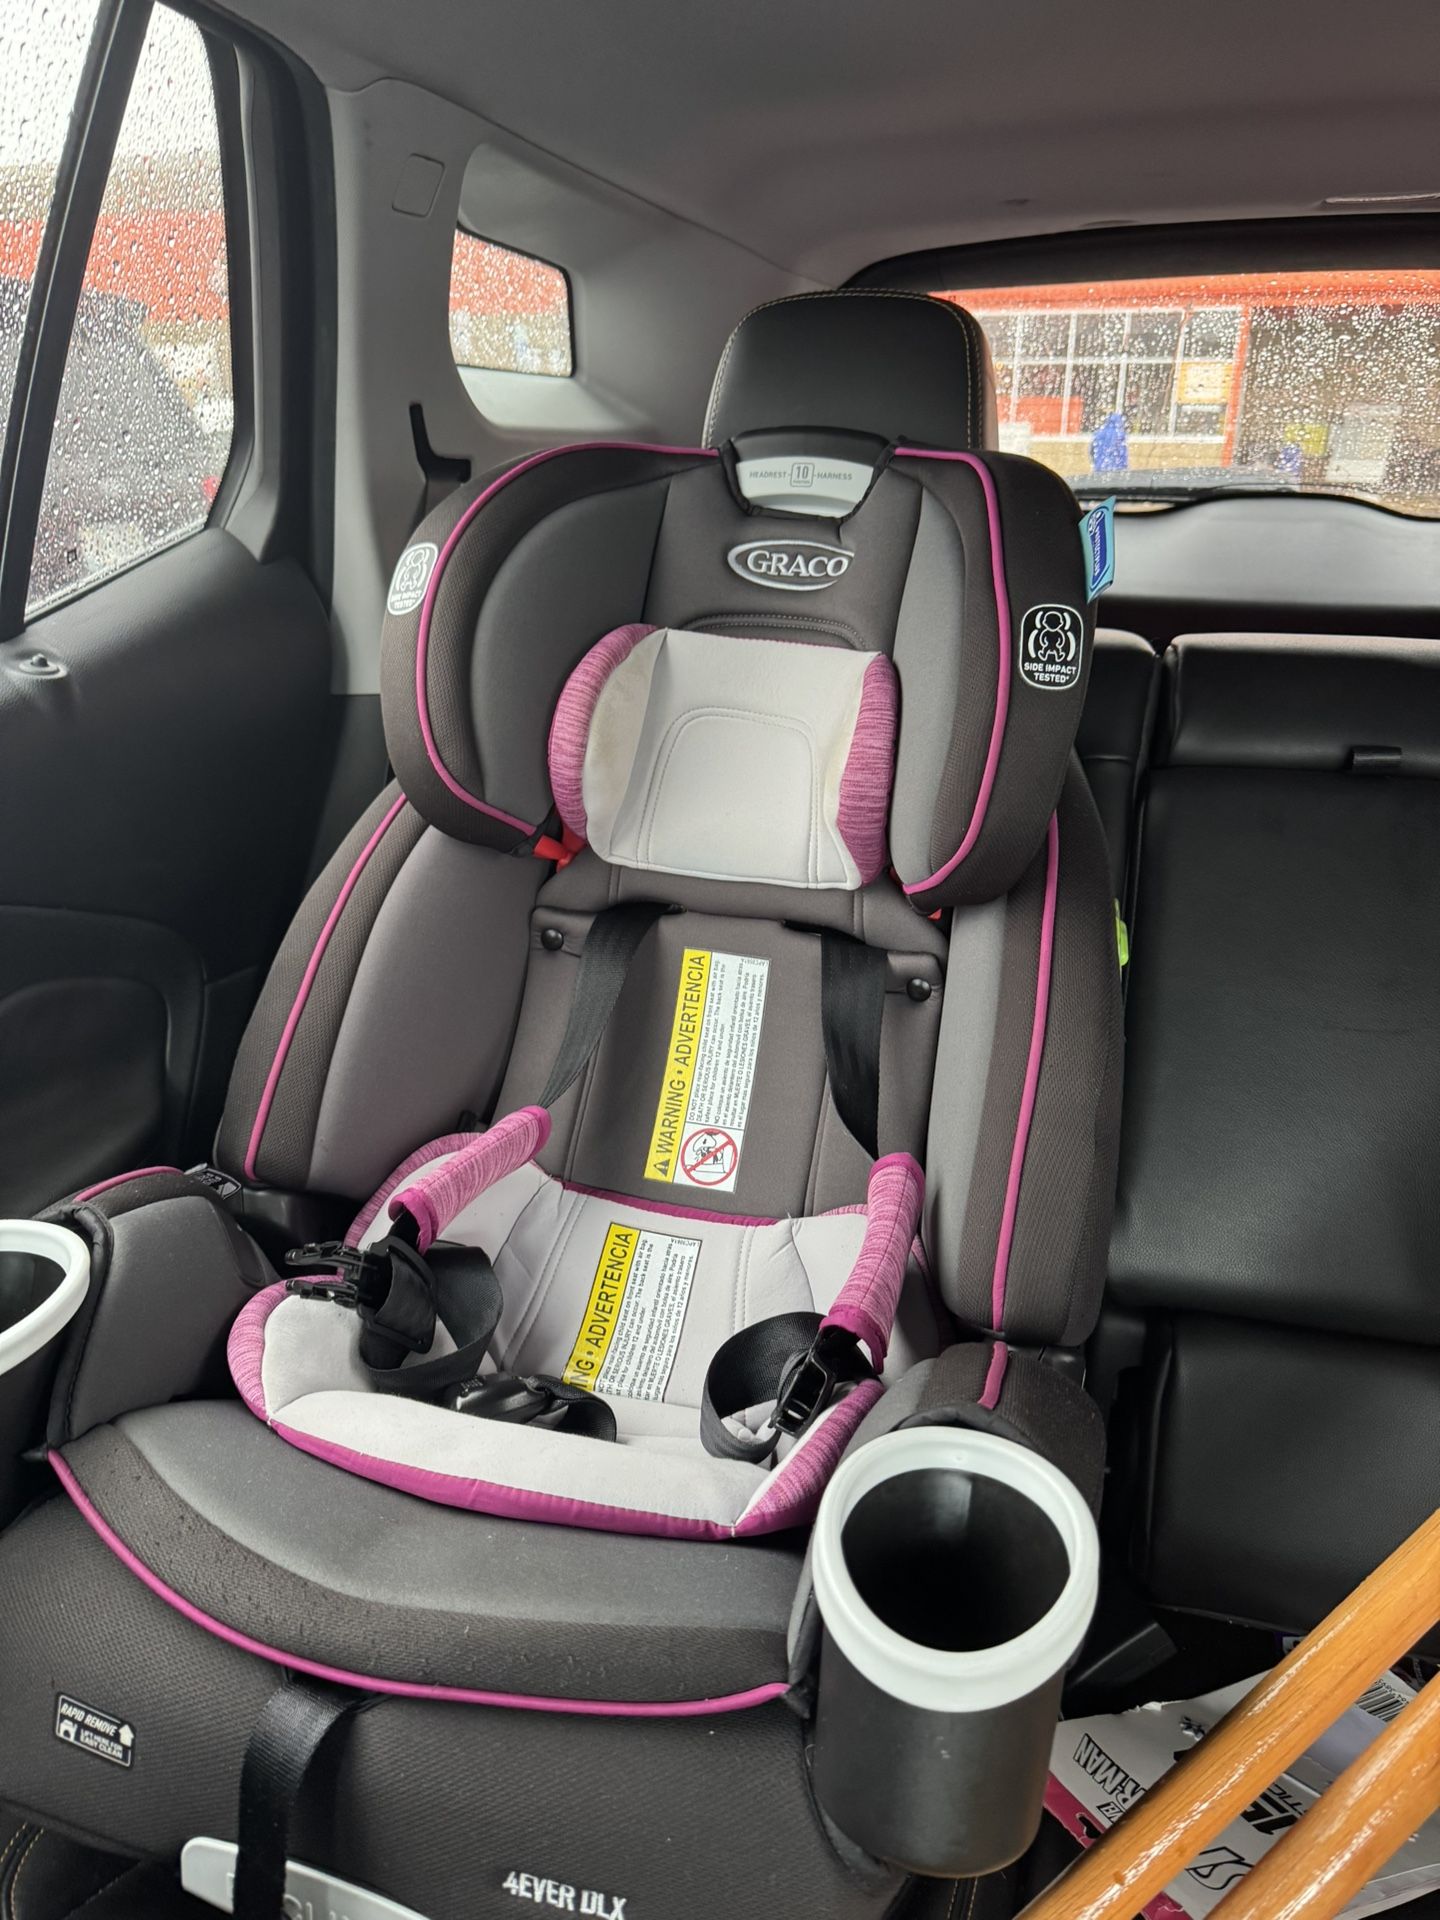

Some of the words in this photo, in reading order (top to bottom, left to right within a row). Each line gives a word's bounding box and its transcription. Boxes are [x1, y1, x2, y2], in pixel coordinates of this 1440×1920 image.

[749, 471, 787, 479] HEADREST
[796, 466, 810, 480] 10
[816, 472, 853, 481] HARNESS
[747, 551, 849, 577] GRACO
[1024, 662, 1044, 672] SIDE
[1045, 663, 1077, 675] IMPACT
[656, 1080, 685, 1152] WARNING
[674, 956, 704, 1066] ADVERTENCIA
[585, 1233, 631, 1347] ADVERTENCIA
[60, 1703, 85, 1722] RAPID
[84, 1714, 117, 1736] REMOVE
[502, 1871, 575, 1911] 4EVER
[579, 1889, 627, 1920] DLX
